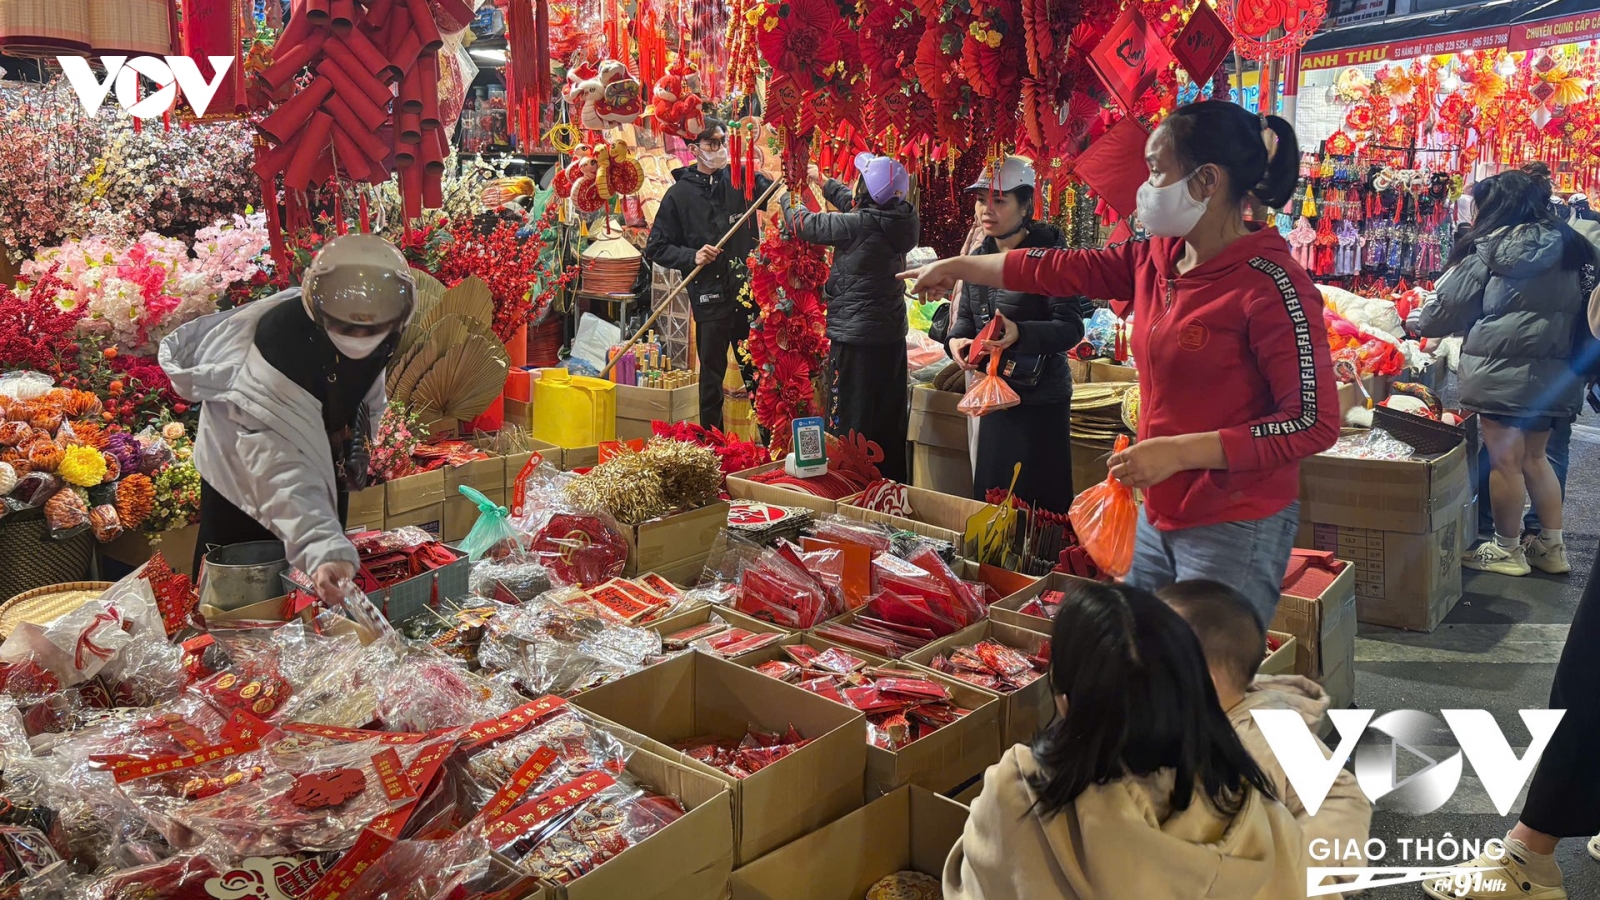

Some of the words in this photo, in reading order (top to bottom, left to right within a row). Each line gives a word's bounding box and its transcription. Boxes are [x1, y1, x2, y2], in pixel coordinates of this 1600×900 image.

[1526, 23, 1553, 40] CHUYÊN
[1553, 21, 1574, 35] CUNG
[1455, 39, 1469, 50] 5254
[1482, 35, 1494, 46] 915
[1301, 54, 1339, 69] ANH
[1345, 45, 1390, 64] THƯ
